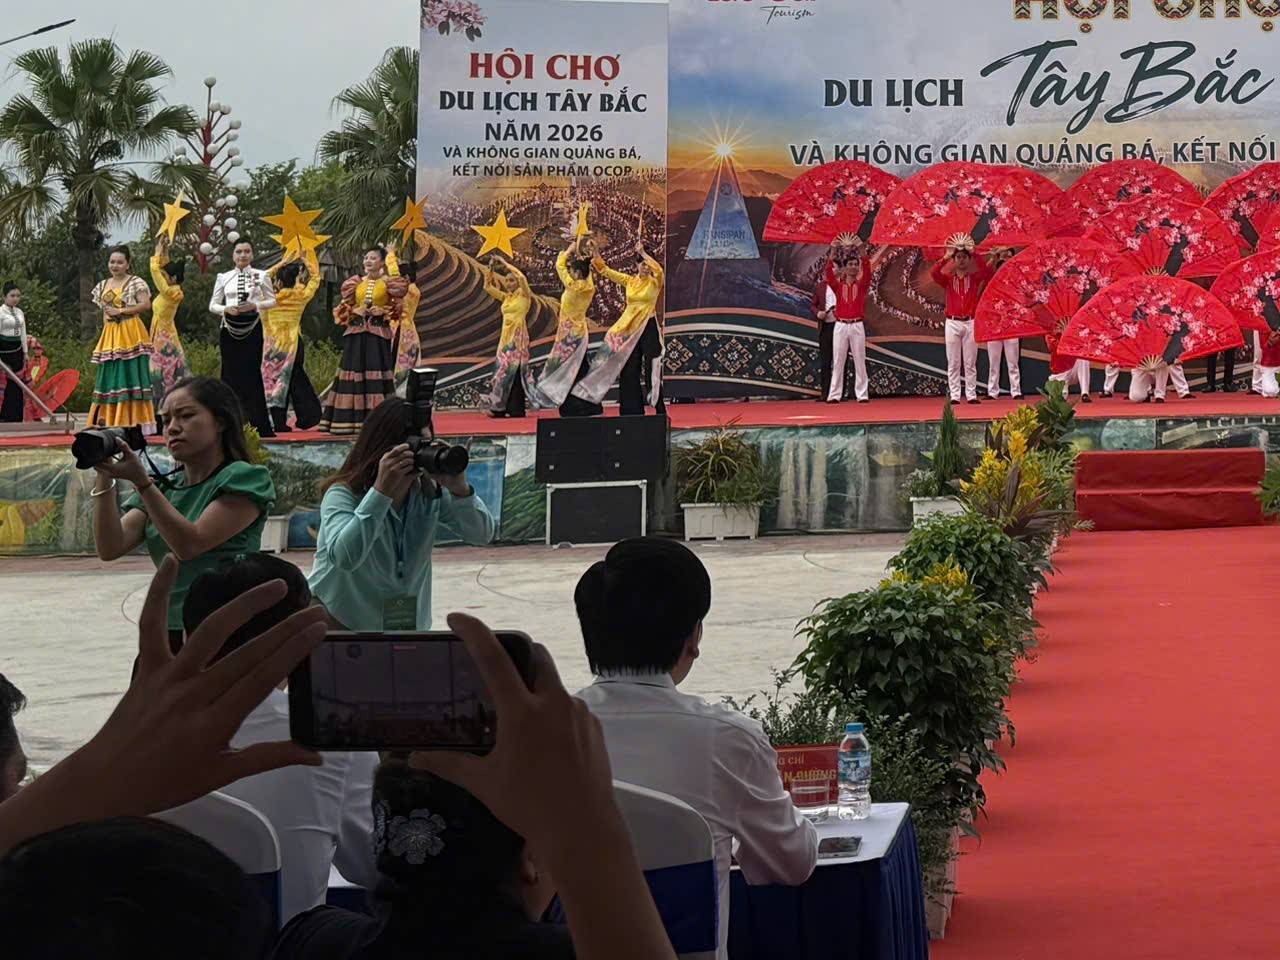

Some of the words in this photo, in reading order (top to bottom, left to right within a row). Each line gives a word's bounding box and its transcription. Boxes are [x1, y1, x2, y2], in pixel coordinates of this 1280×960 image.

[759, 5, 816, 24] Tourism
[469, 48, 534, 85] HỘI
[546, 54, 621, 87] CHỢ
[824, 79, 873, 107] DU
[885, 78, 964, 113] LỊCH
[980, 39, 1111, 135] Tây
[1103, 40, 1274, 124] Bắc
[439, 90, 474, 110] DU
[483, 91, 538, 115] LỊCH
[545, 88, 592, 112] TÂY
[600, 86, 647, 113] BẮC
[485, 119, 541, 142] NĂM
[547, 124, 603, 142] 2026
[443, 145, 462, 159] VÀ
[467, 145, 519, 159] KHÔNG
[524, 147, 559, 159] GIAN
[619, 145, 642, 161] BÁ,
[790, 141, 826, 165] VÀ
[835, 140, 932, 164] KHÔNG
[941, 143, 1007, 164] GIAN
[1015, 137, 1113, 165] QUẢNG
[1122, 139, 1164, 164] BÁ,
[1173, 136, 1220, 162] KẾT
[1229, 135, 1275, 161] NỐI
[452, 162, 480, 177] KẾT
[484, 162, 510, 177] NỐI
[547, 161, 589, 177] PHẨM
[593, 165, 632, 177] OCOP
